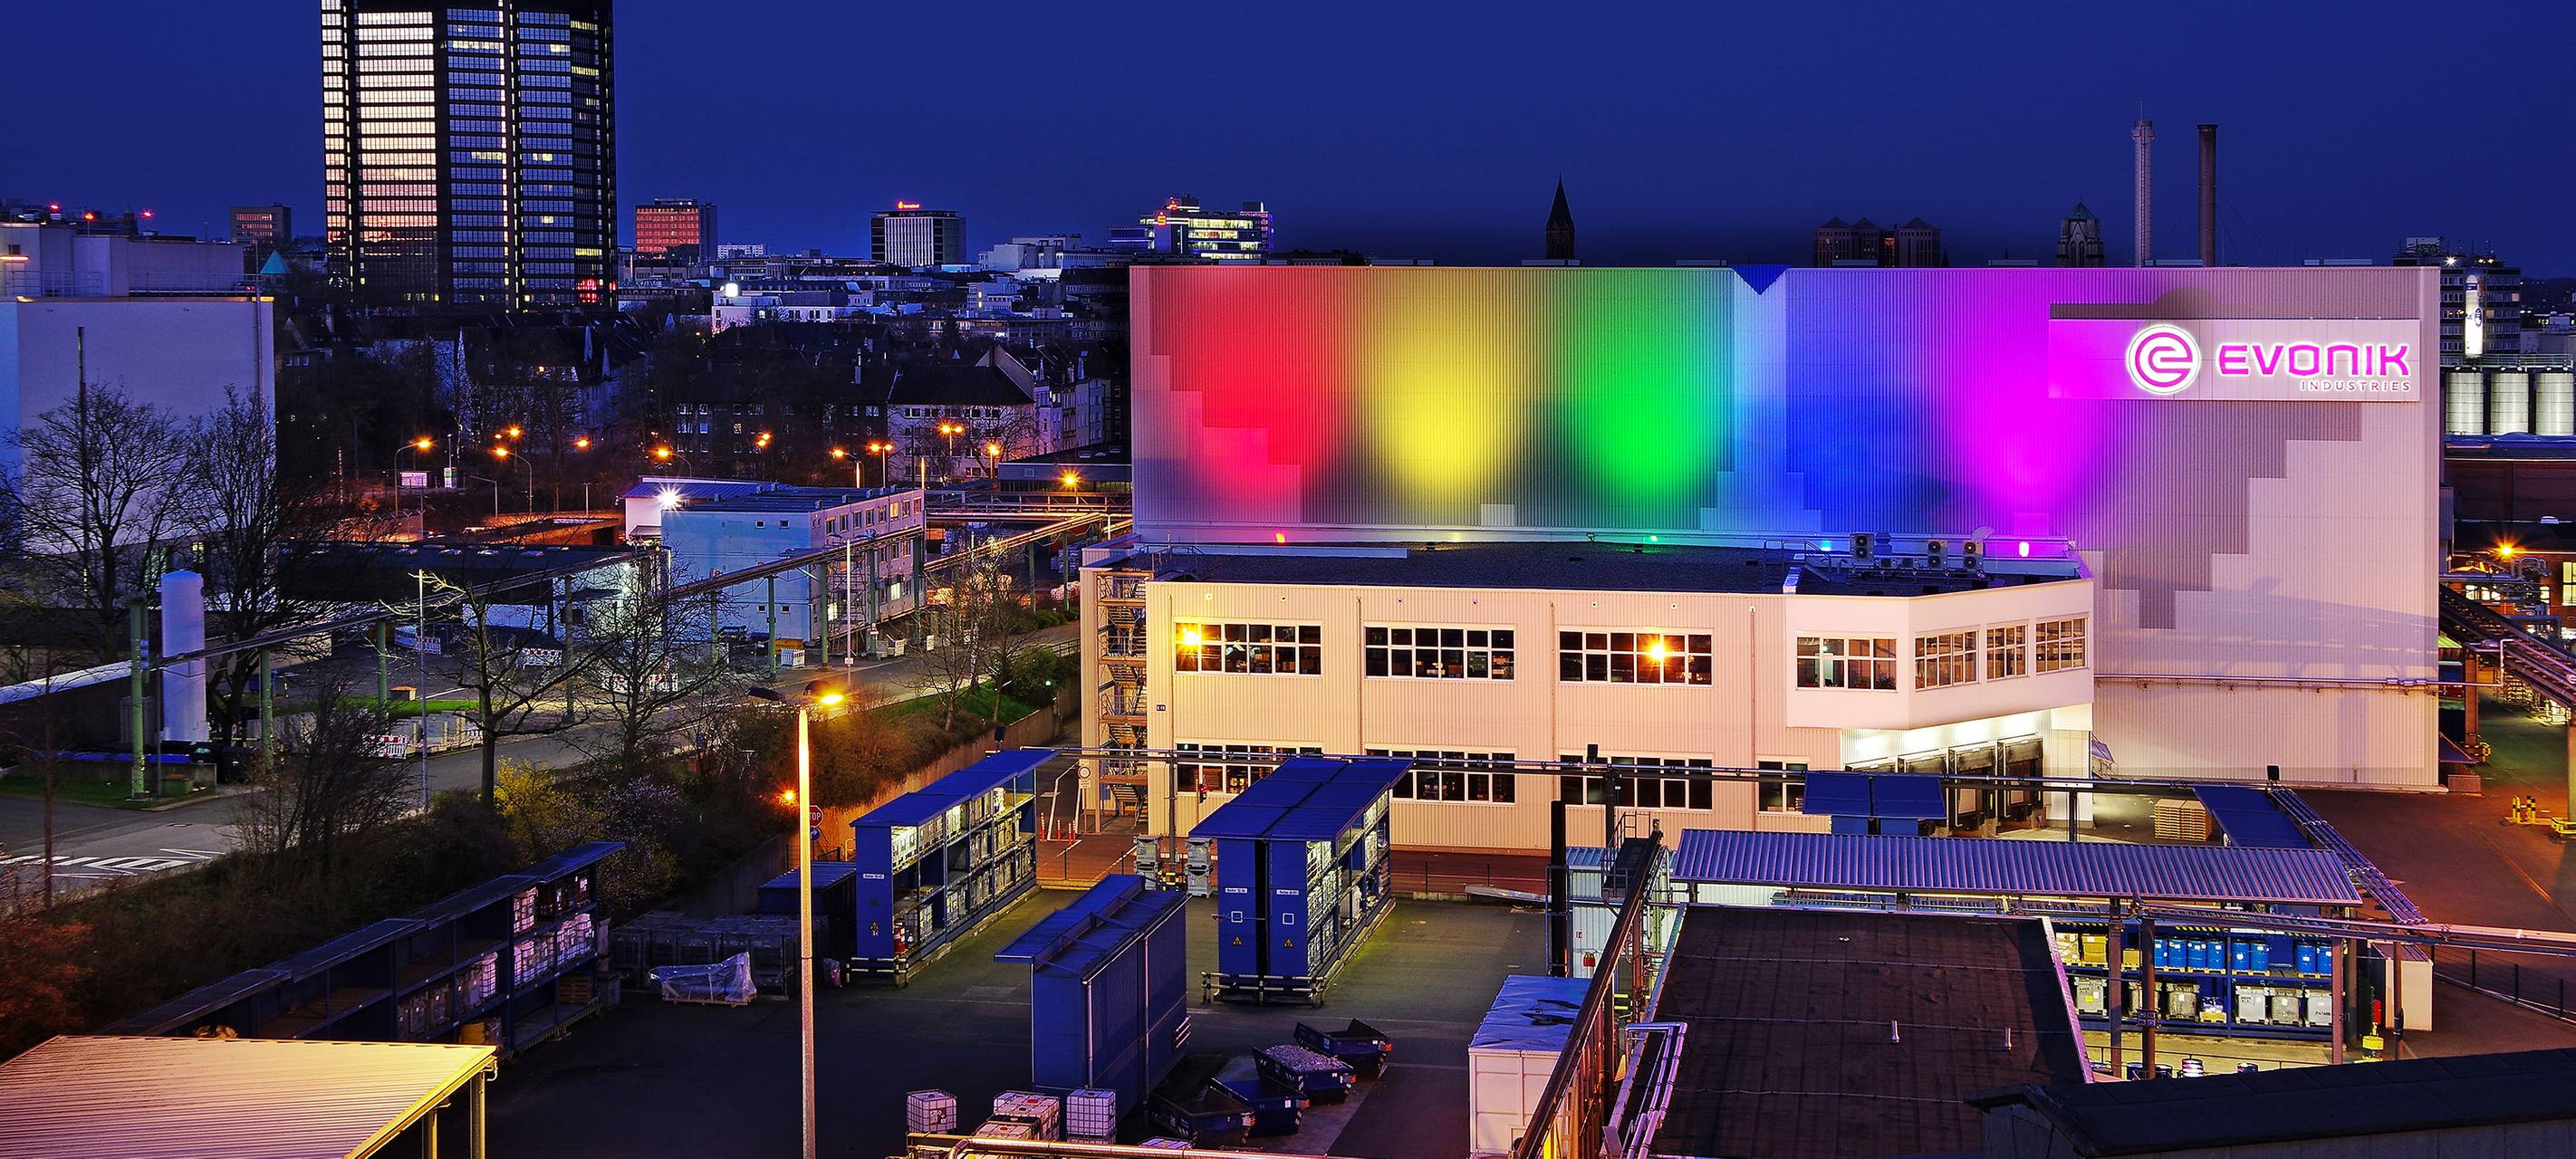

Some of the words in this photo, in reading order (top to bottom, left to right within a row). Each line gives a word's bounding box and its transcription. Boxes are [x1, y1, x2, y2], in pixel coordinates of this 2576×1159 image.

[2219, 344, 2409, 377] EVONIK
[2302, 380, 2410, 391] INDUSTRIES
[810, 812, 822, 821] OP
